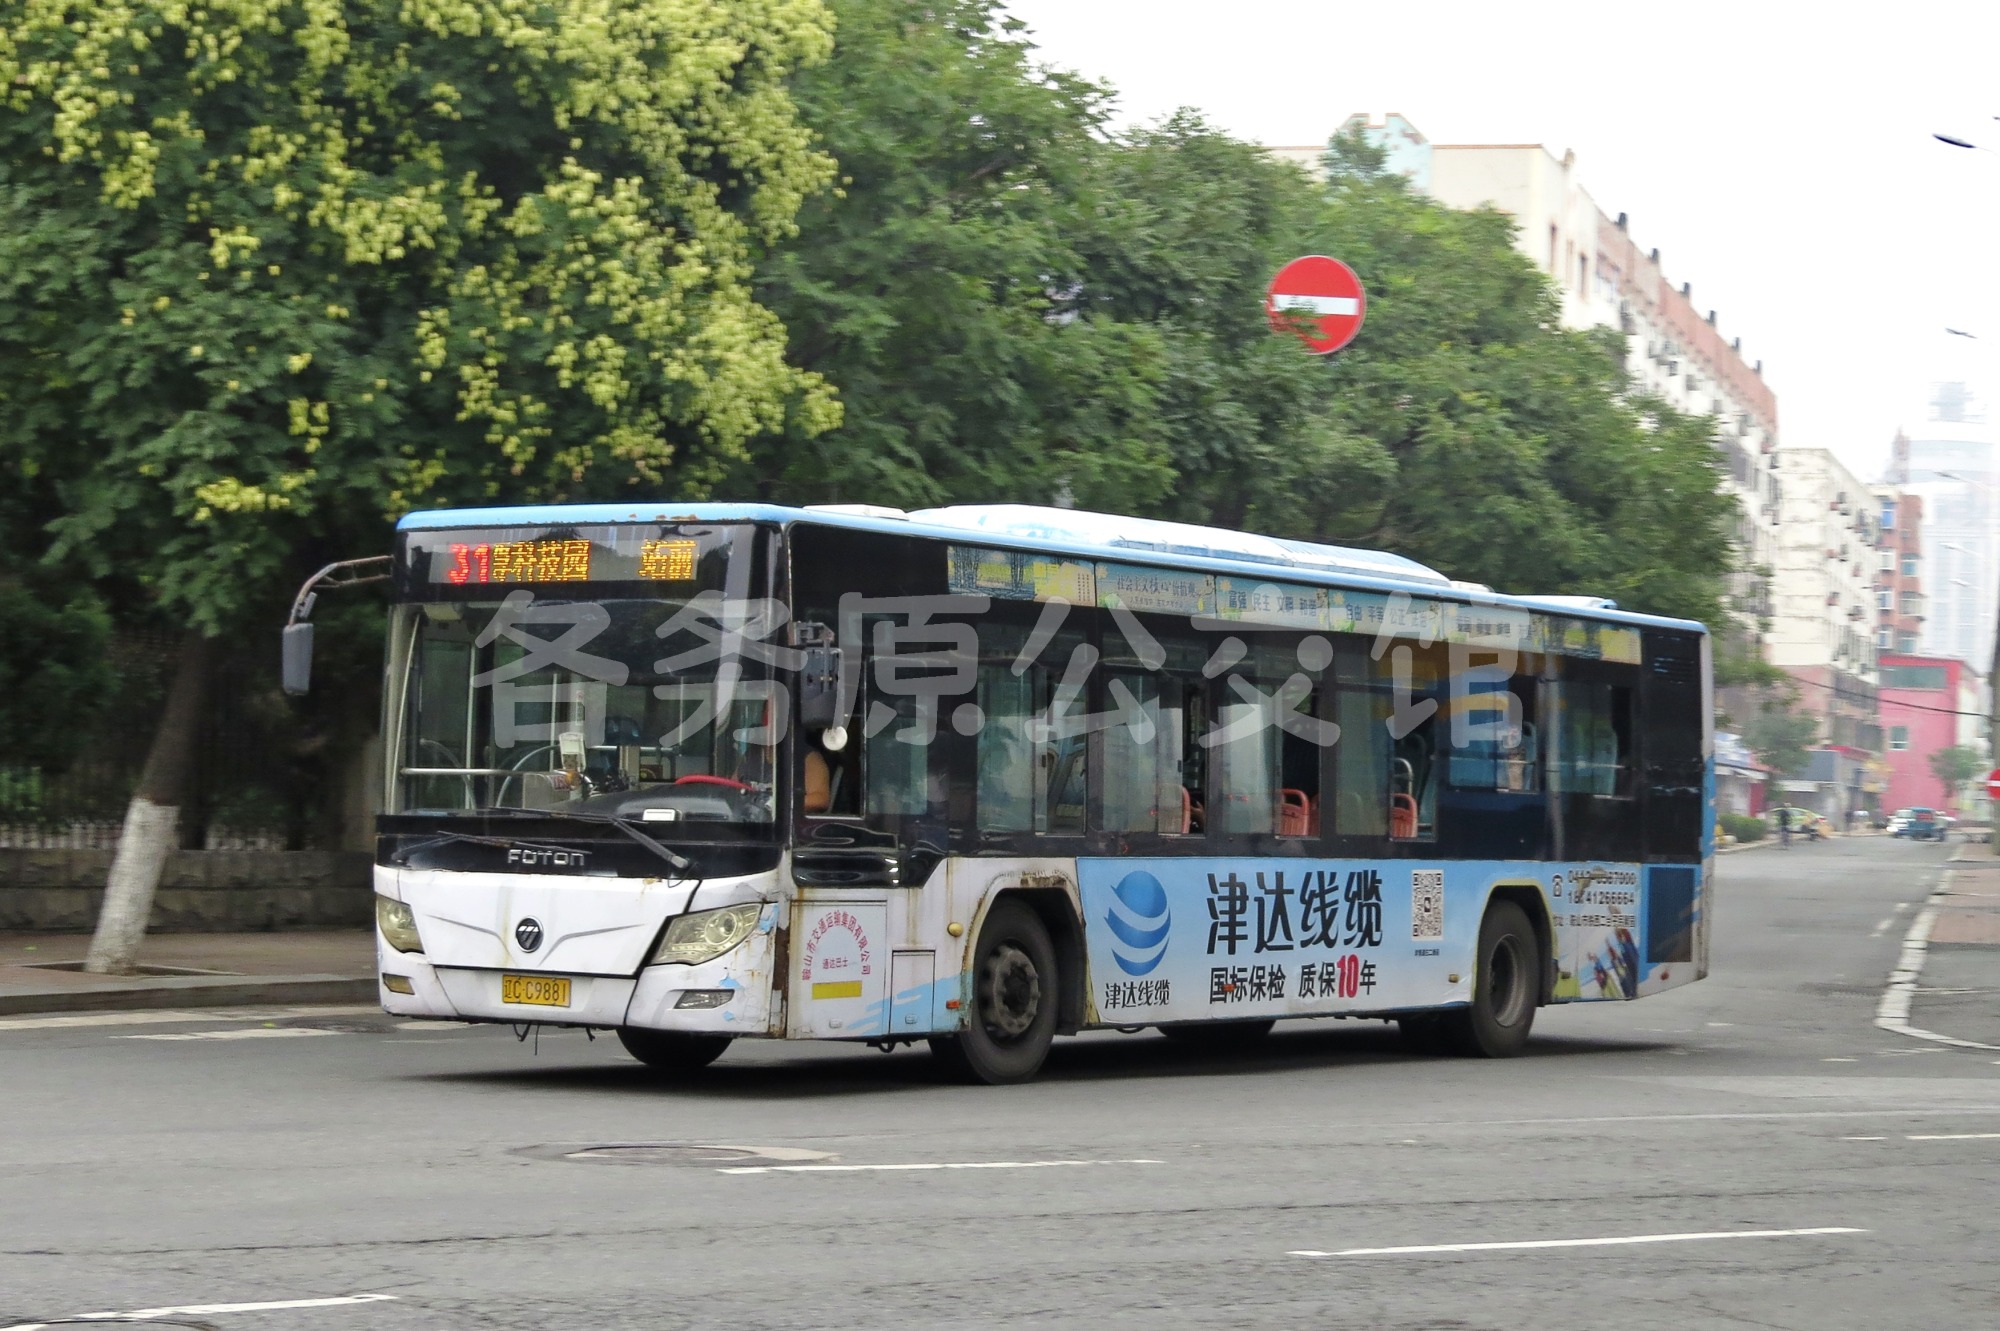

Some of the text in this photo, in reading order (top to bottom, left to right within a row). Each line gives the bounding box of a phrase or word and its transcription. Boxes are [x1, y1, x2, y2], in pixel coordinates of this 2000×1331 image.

[449, 543, 491, 583] 31
[1253, 593, 1271, 612] 民主
[508, 848, 585, 867] FOTON
[1206, 869, 1383, 955] 津达线缆
[1104, 979, 1170, 1010] 津达线缆
[1209, 953, 1377, 1005] 国标保检 质保10年
